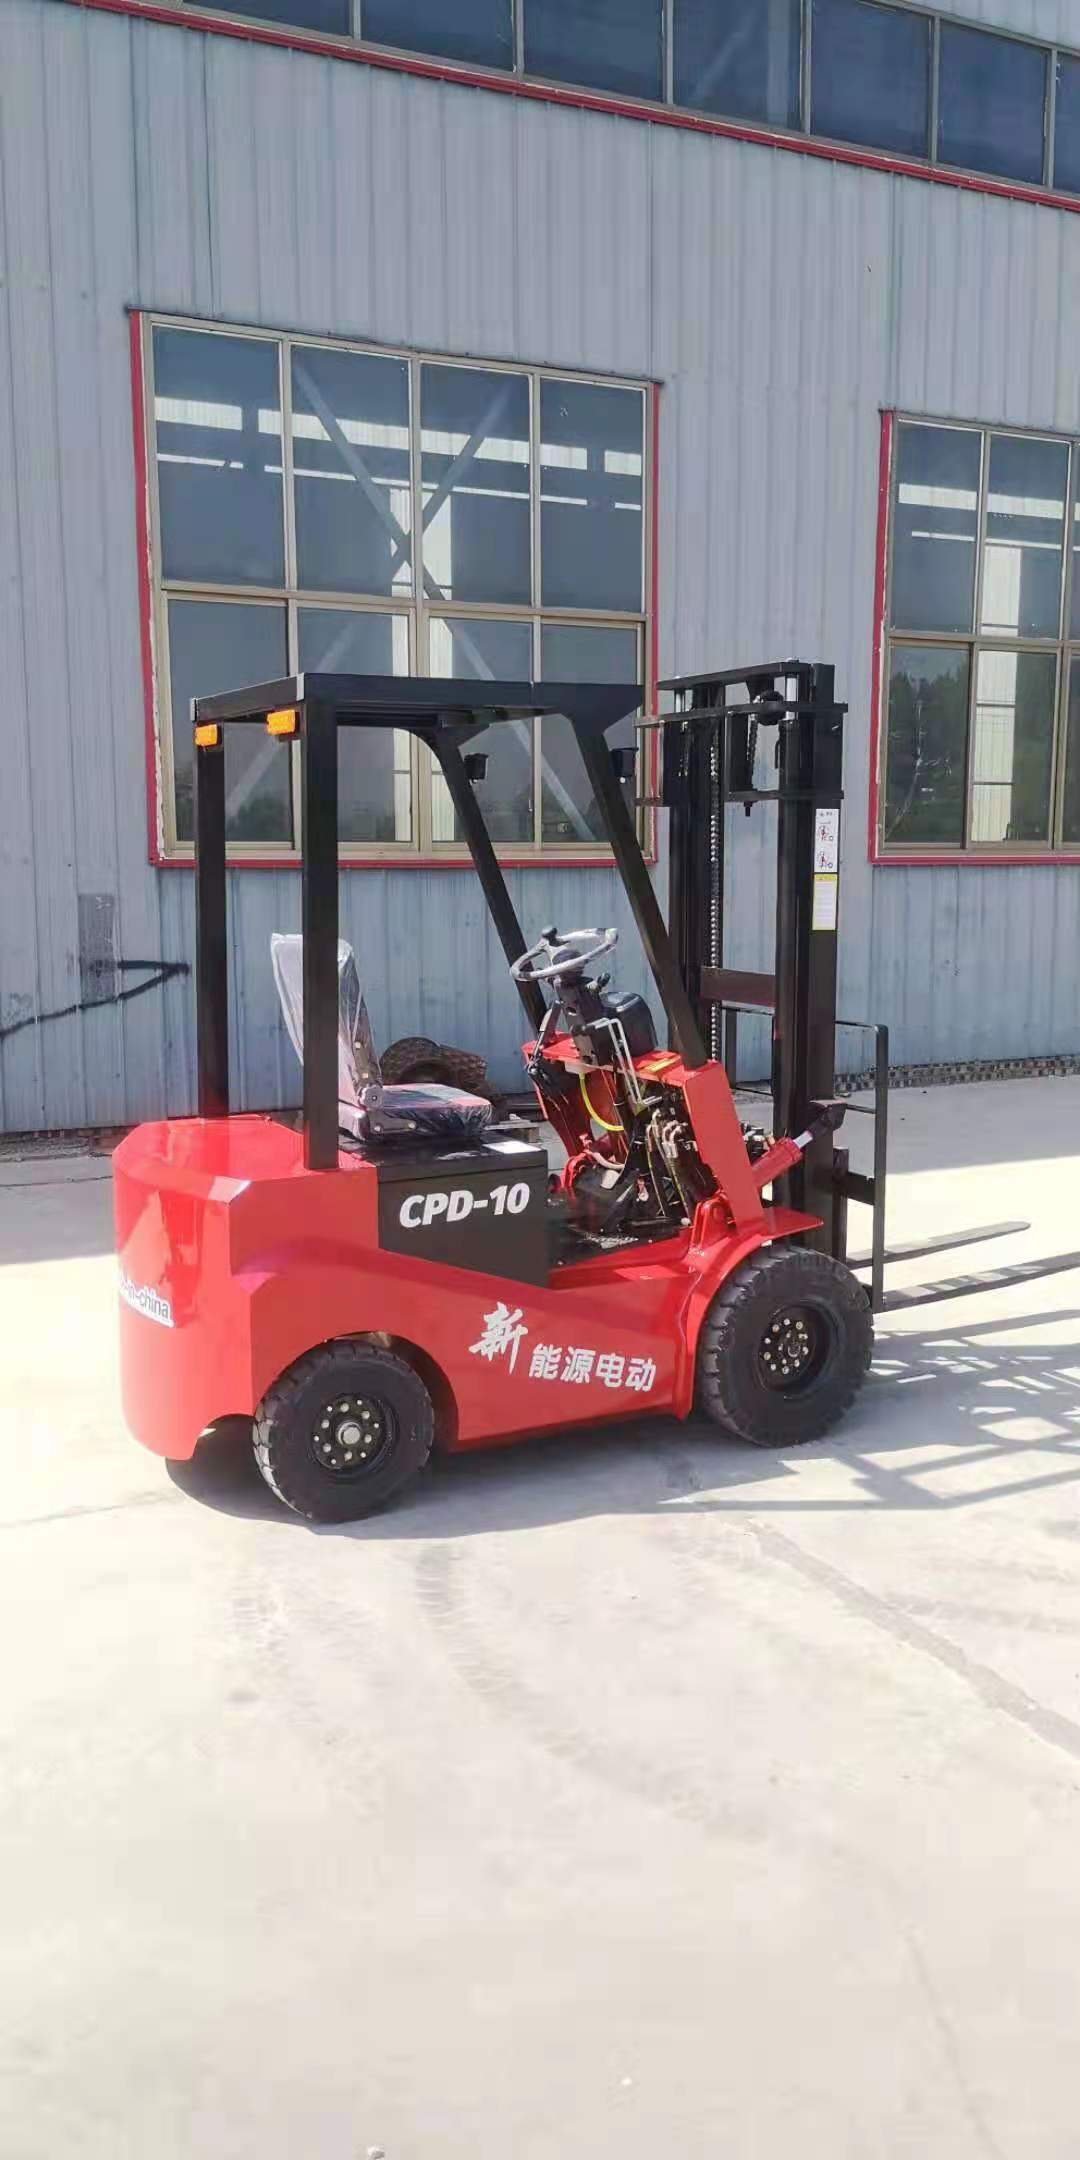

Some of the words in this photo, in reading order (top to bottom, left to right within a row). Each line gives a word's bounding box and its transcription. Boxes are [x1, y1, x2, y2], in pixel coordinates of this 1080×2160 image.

[399, 1182, 530, 1228] CPD-10
[468, 1301, 657, 1392] 新能源电动
